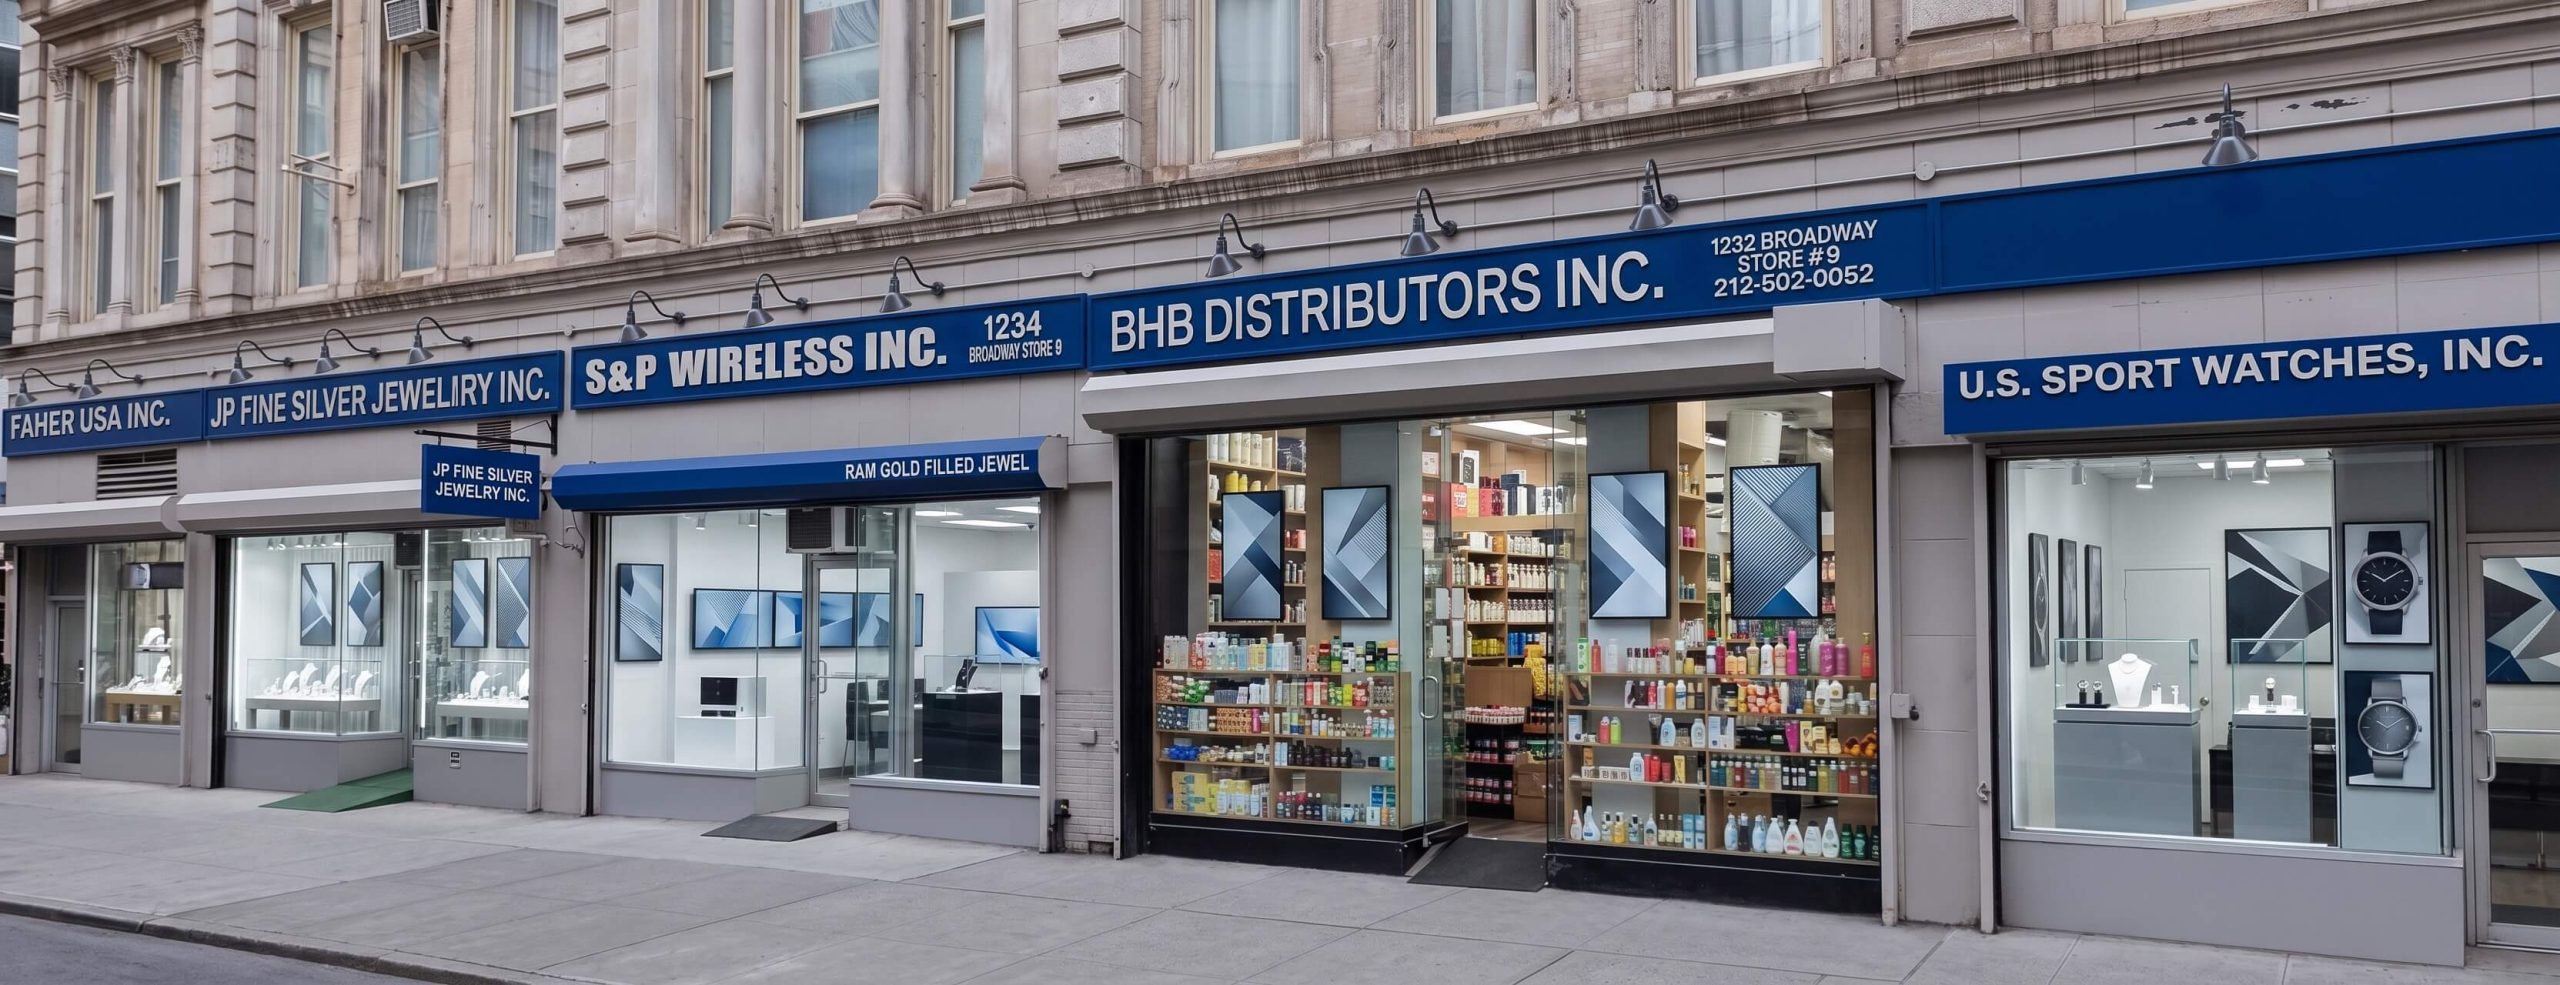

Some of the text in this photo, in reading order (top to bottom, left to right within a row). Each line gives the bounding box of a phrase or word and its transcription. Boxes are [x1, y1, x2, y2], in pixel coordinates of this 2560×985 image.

[1711, 219, 1878, 256] 1232 BROADWAY
[1738, 249, 1804, 274] STORE
[1714, 263, 1874, 298] 212-502-0052
[1111, 250, 1664, 353] BHB DISTRIBUTORS INC.
[983, 310, 1042, 341] 1234
[585, 326, 947, 395] S&P WIRELESS INC.
[969, 338, 1063, 363] BROADWAY STORE 9
[1959, 334, 2543, 399] U.S. SPORT WATCHES, INC.
[210, 397, 236, 428] JP
[240, 392, 287, 426] FINE
[291, 384, 367, 421] SILVER
[500, 367, 550, 403] INC.
[10, 399, 170, 440] FAHER USA INC.
[432, 462, 533, 485] JP FINE SILVER
[845, 453, 1030, 480] RAM GOLD FILLED JEWEL
[435, 482, 530, 503] JEWELRY INC.
